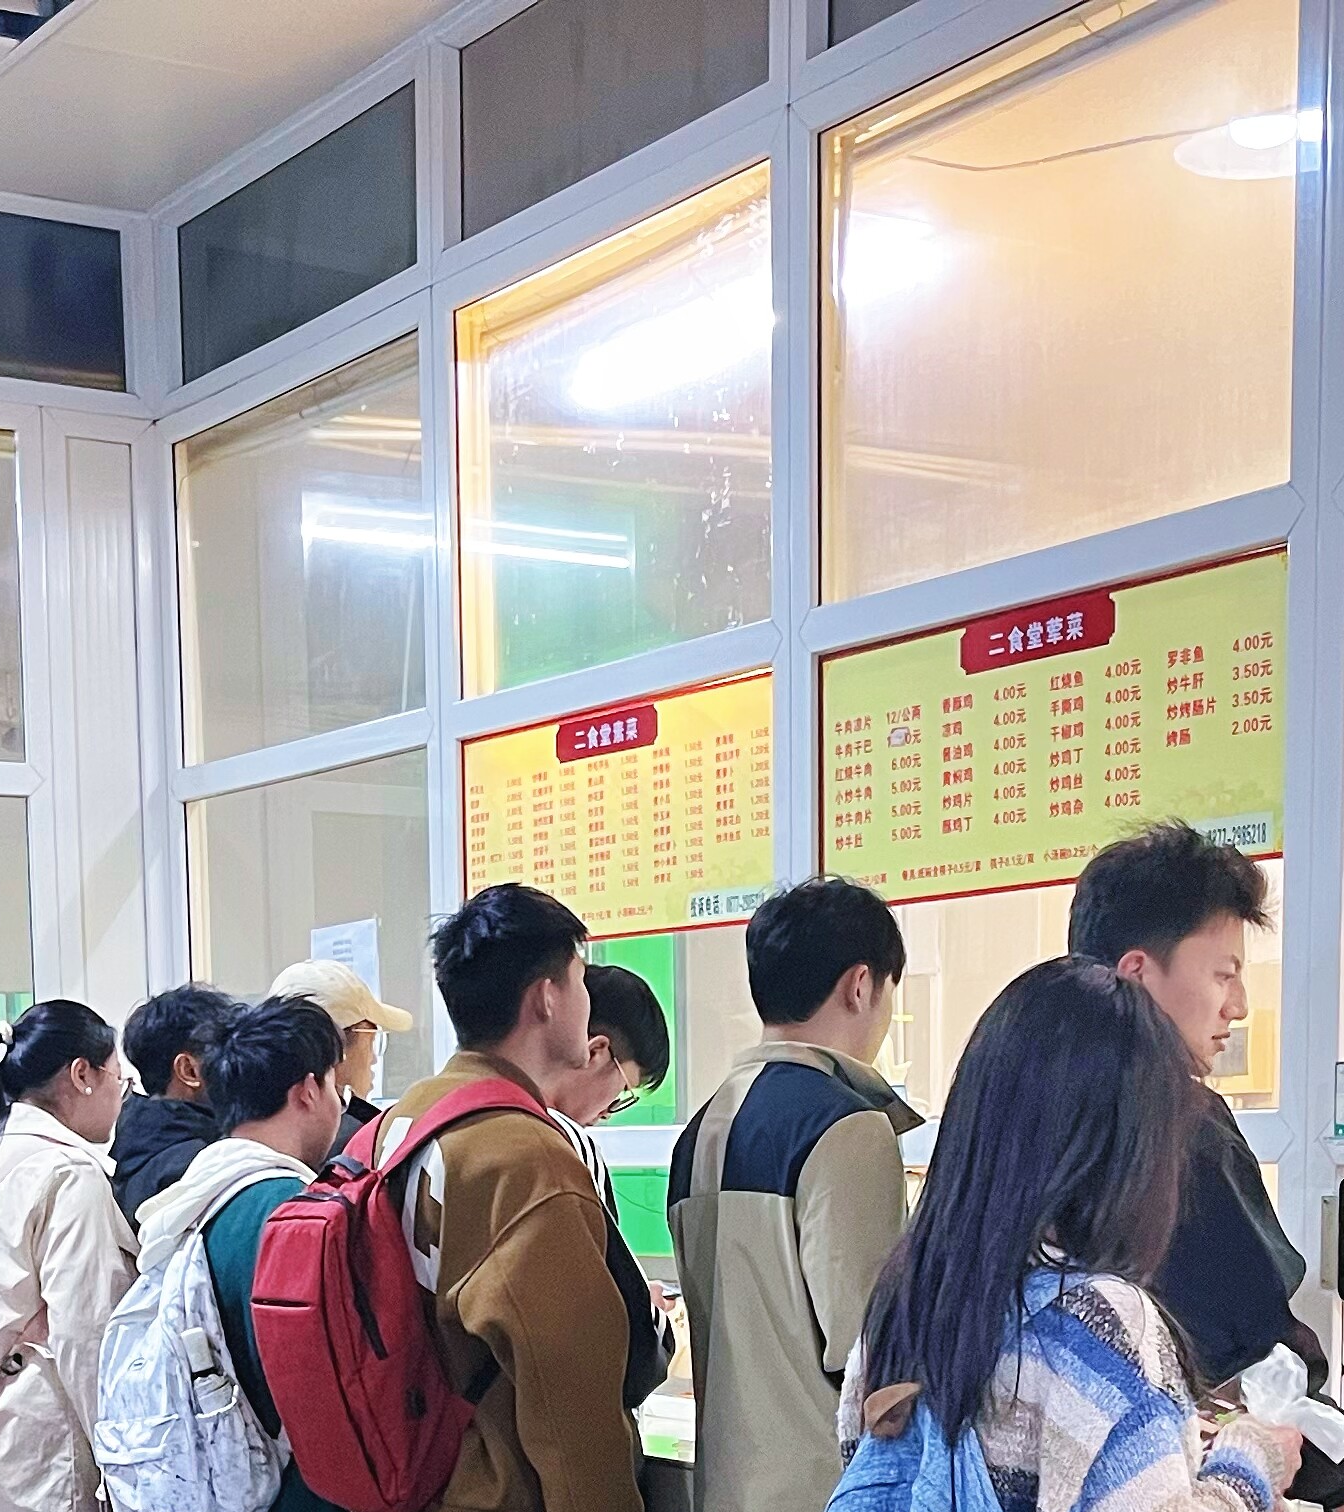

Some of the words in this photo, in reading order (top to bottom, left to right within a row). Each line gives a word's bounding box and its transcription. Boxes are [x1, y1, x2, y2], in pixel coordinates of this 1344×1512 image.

[989, 612, 1083, 655] 二食堂荤菜
[1167, 643, 1205, 668] 罗非鱼
[1232, 632, 1274, 653] 4.00元
[1104, 657, 1142, 679] 4.00元
[1232, 660, 1272, 680] 3.50元
[993, 682, 1026, 702] 4.00元
[1105, 685, 1141, 703] 4.00元
[1165, 696, 1216, 719] 炒烤肠片
[1233, 687, 1271, 707] 3.50元
[992, 709, 1026, 726] 4.00元
[1105, 711, 1141, 730] 4.00元
[1164, 727, 1192, 747] 烤肠
[1232, 714, 1272, 735] 2.00元
[993, 733, 1026, 750] 4.00元
[1105, 737, 1141, 757] 4.00元
[994, 760, 1026, 776] 4.00元
[1105, 763, 1140, 781] 4.00元
[993, 783, 1025, 800] 4.00元
[1104, 789, 1141, 808] 4.00元
[993, 808, 1027, 826] 4.00元
